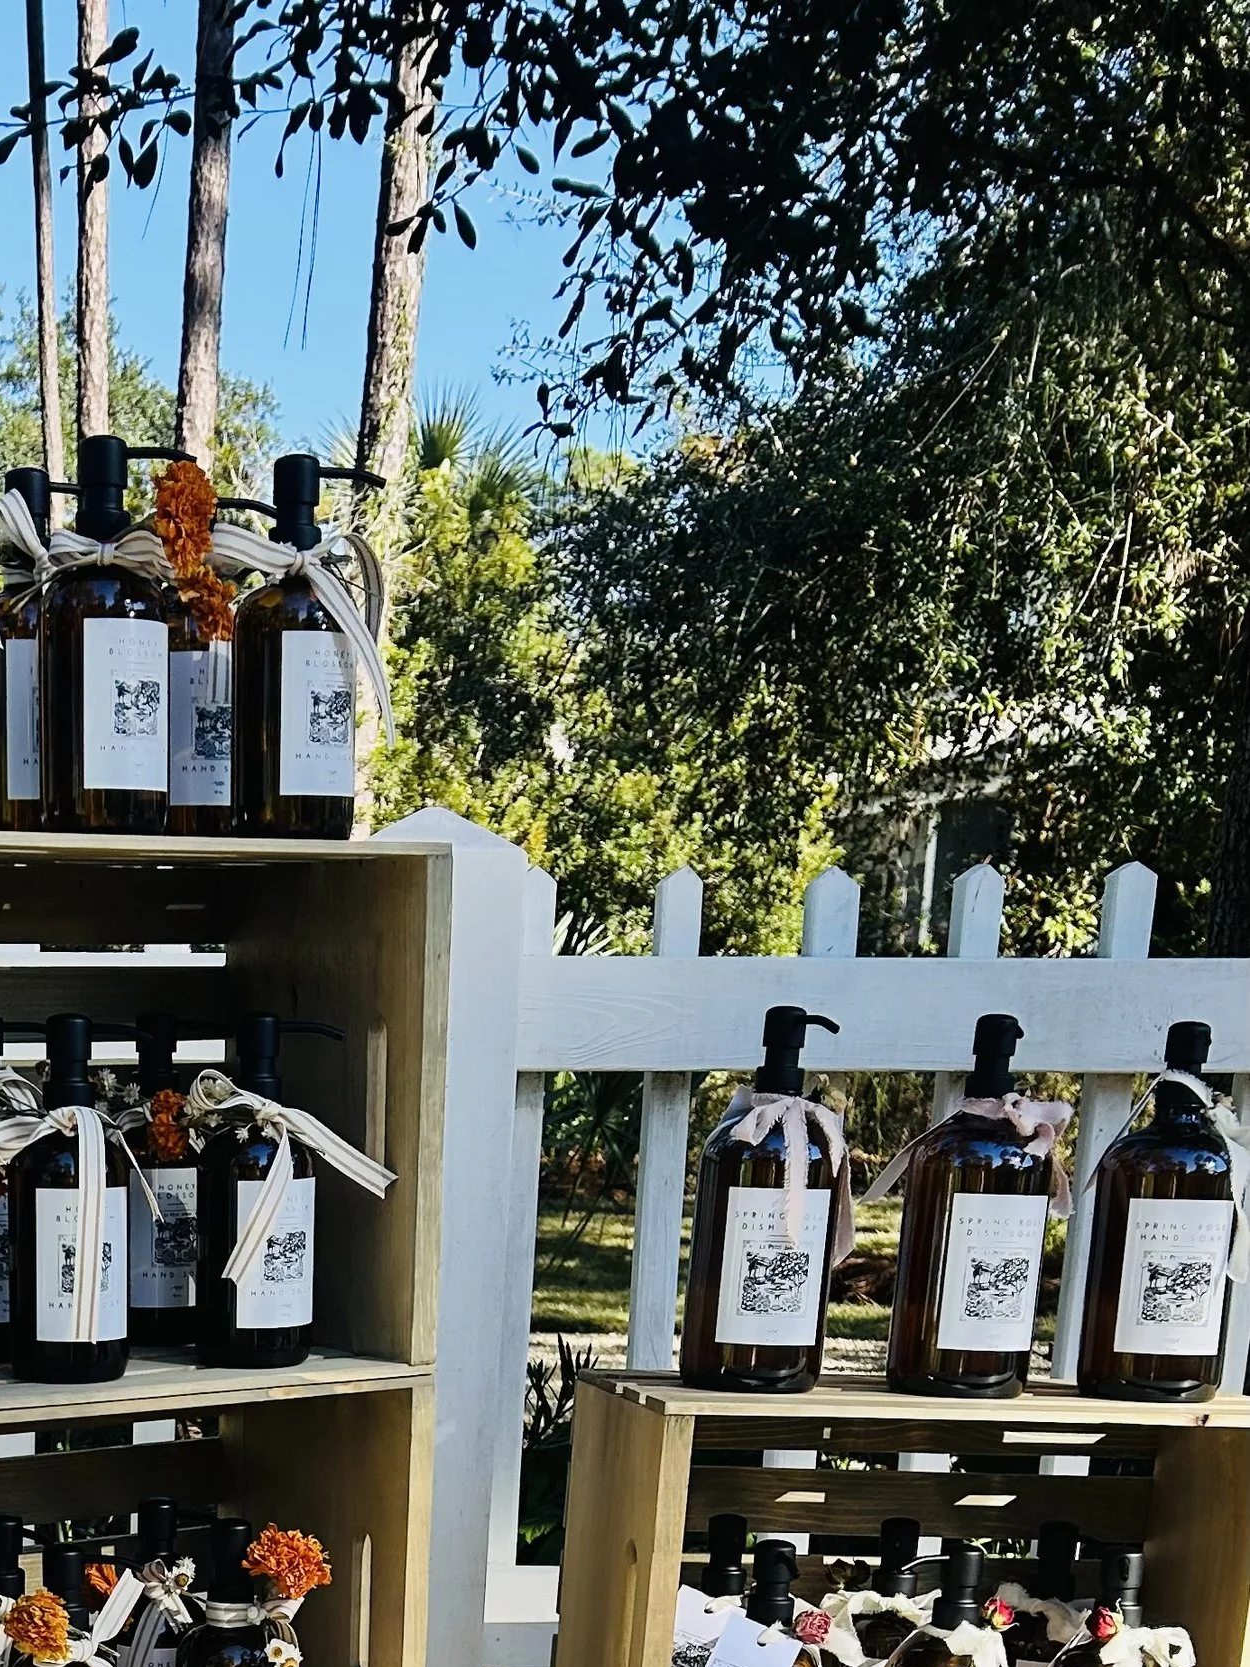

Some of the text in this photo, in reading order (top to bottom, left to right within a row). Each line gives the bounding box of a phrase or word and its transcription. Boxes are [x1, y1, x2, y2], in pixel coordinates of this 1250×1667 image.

[182, 764, 216, 774] HAND
[742, 1222, 775, 1231] DISH
[959, 1217, 1010, 1227] SPRING
[1136, 1221, 1189, 1231] SPRING
[1140, 1233, 1180, 1242] HAND
